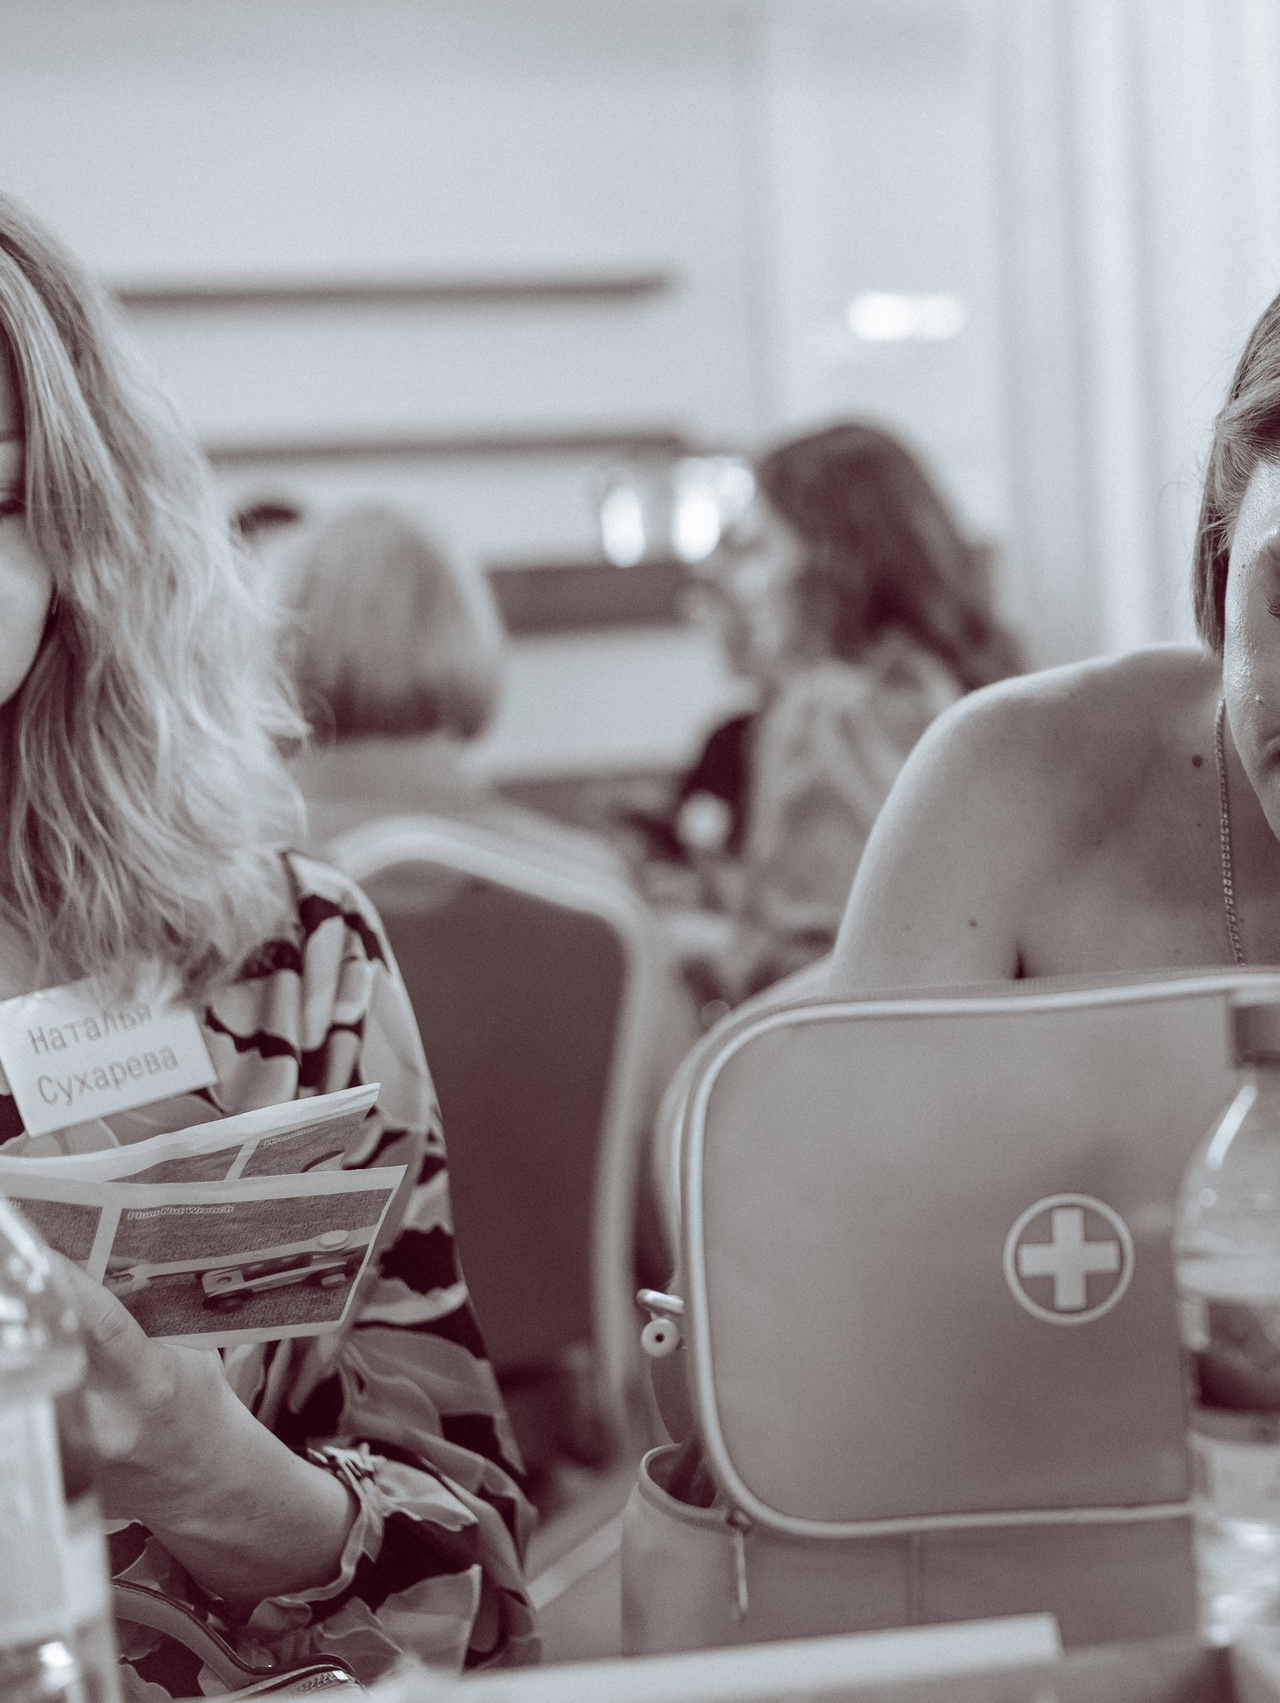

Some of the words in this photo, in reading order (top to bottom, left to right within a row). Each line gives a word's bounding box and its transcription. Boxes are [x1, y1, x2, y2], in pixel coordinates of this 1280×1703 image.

[28, 1001, 153, 1056] Наталья
[37, 1046, 179, 1107] Сухарева
[160, 1207, 185, 1216] Nut
[185, 1205, 235, 1216] Wrench
